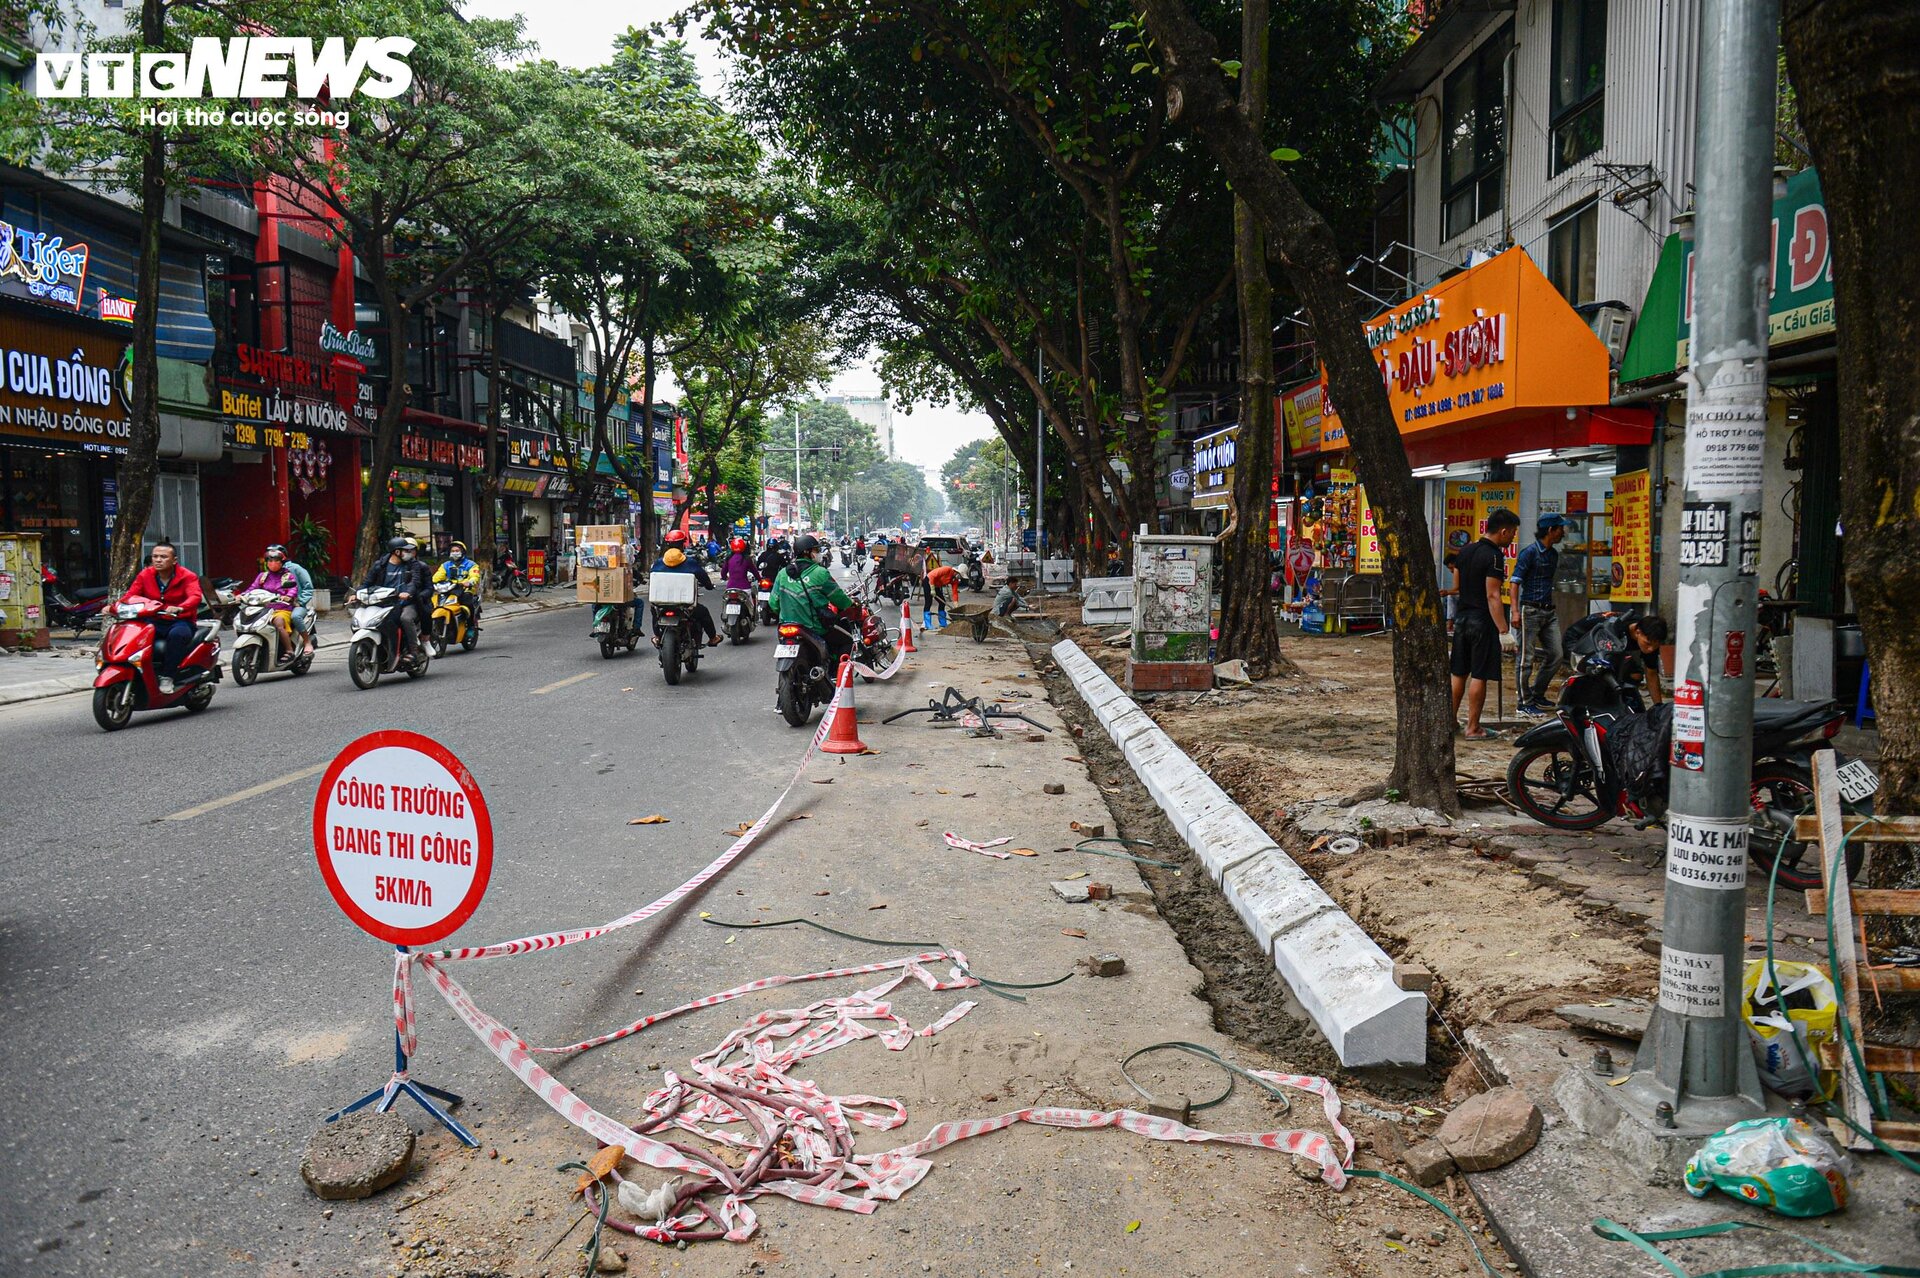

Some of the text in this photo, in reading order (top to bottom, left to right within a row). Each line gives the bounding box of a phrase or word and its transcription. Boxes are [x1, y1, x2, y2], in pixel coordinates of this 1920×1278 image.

[16, 228, 86, 284] Tiger
[1783, 311, 1807, 336] Cầu
[1444, 308, 1506, 378] SƯỜN
[9, 347, 111, 406] CUA ĐỒNG
[358, 383, 373, 402] 291
[16, 406, 58, 432] NHẬU
[222, 389, 262, 419] Buffet
[293, 402, 303, 425] &
[306, 401, 348, 432] NƯỚNG
[1695, 503, 1726, 532] TIỀN
[337, 776, 464, 819] CÔNG TRƯỜNG
[334, 825, 472, 867] ĐANG THI CÔNG
[1671, 819, 1694, 845] SỬA
[1699, 830, 1719, 849] XE
[1691, 850, 1724, 867] ĐỘNG
[375, 875, 432, 908] 5KM/h
[1684, 956, 1713, 971] MÁY
